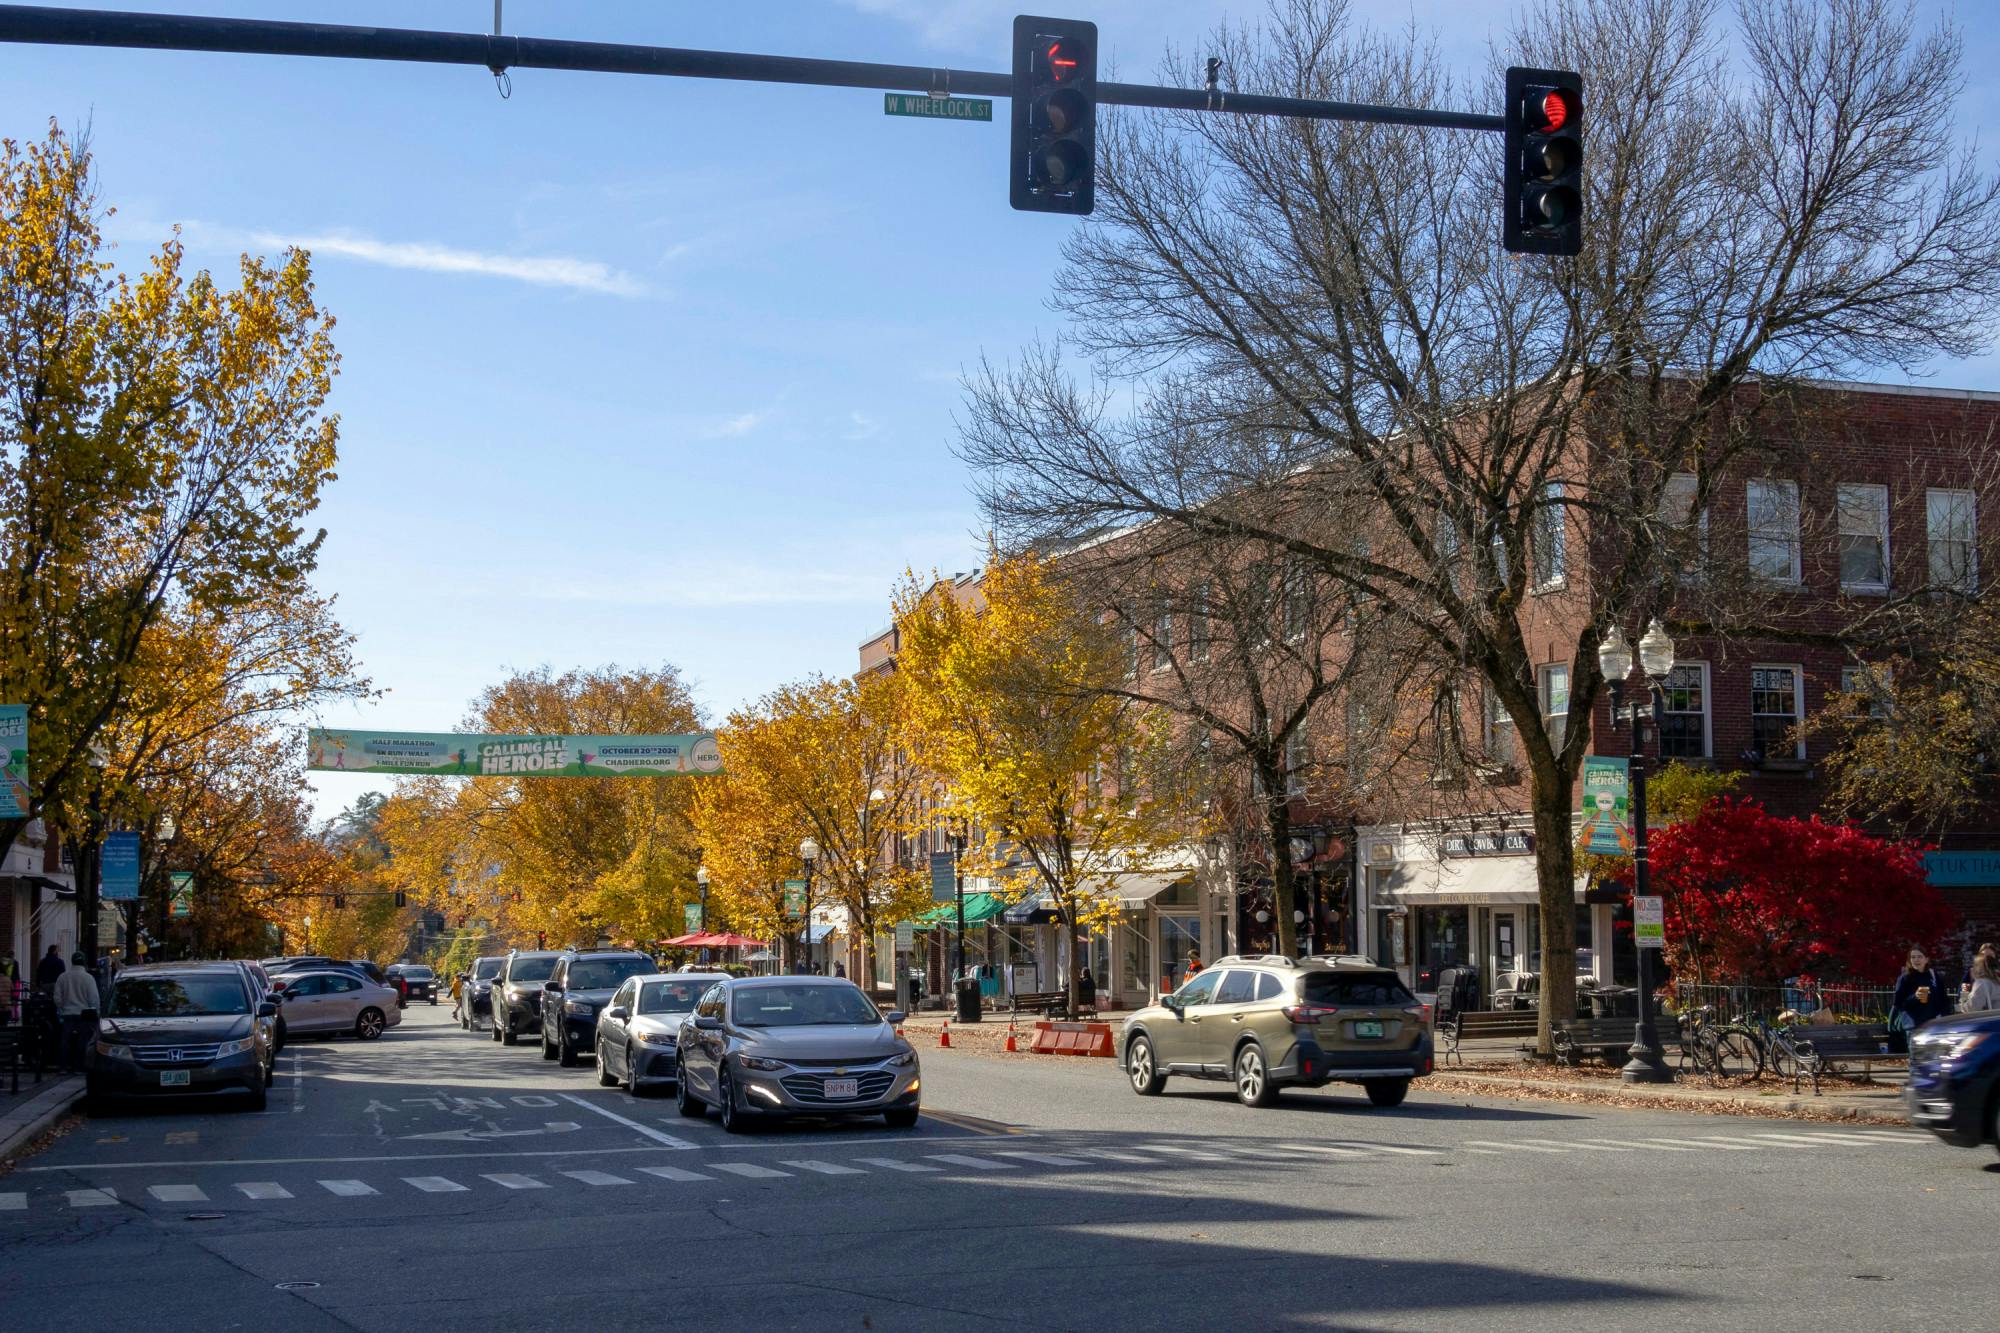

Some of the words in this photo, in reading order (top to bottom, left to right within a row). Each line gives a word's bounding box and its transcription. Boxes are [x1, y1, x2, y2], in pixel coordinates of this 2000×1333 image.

[887, 96, 898, 113] W
[905, 97, 972, 117] WHEELOCK
[978, 104, 989, 116] ST
[372, 739, 391, 747] HALF
[392, 739, 435, 747] MARATHON
[483, 742, 542, 757] CALLING
[543, 740, 568, 752] ALL
[602, 747, 640, 755] OCTOBER
[399, 759, 414, 767] FUN
[482, 751, 568, 775] HEROES
[697, 754, 719, 762] HERO
[1937, 858, 1968, 873] TUK
[1970, 858, 2000, 873] THA
